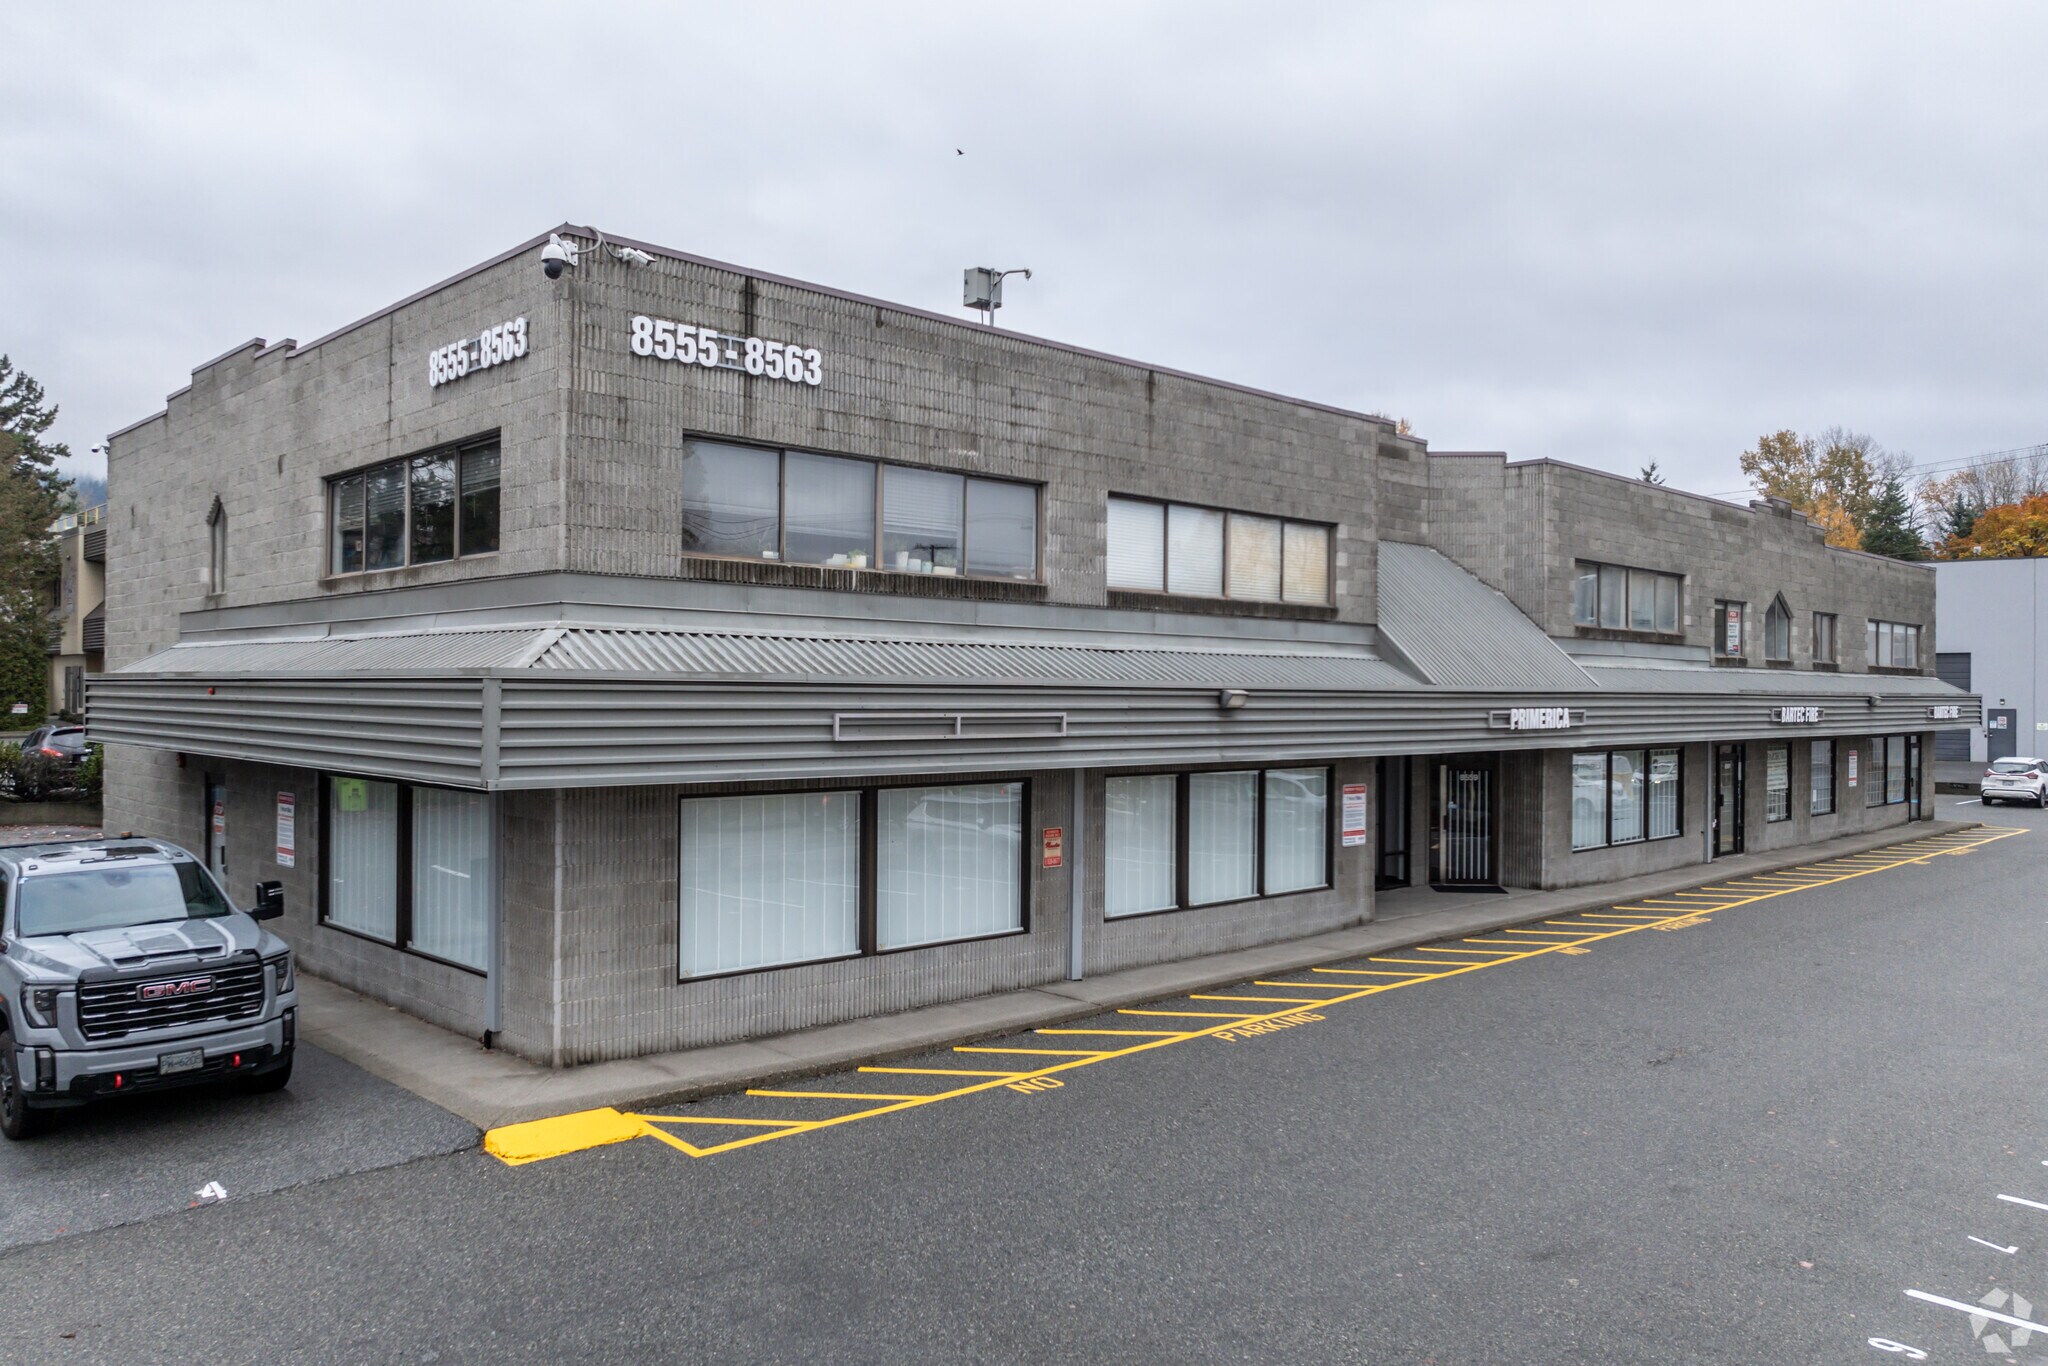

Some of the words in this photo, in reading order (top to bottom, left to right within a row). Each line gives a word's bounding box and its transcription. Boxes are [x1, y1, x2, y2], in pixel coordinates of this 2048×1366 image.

[1510, 708, 1570, 730] PRIMERICA
[1781, 706, 1805, 723] BARTEC
[1805, 706, 1819, 722] FIRE
[143, 979, 212, 998] GMC
[1006, 1077, 1064, 1094] NO
[1212, 1012, 1326, 1042] PARKING
